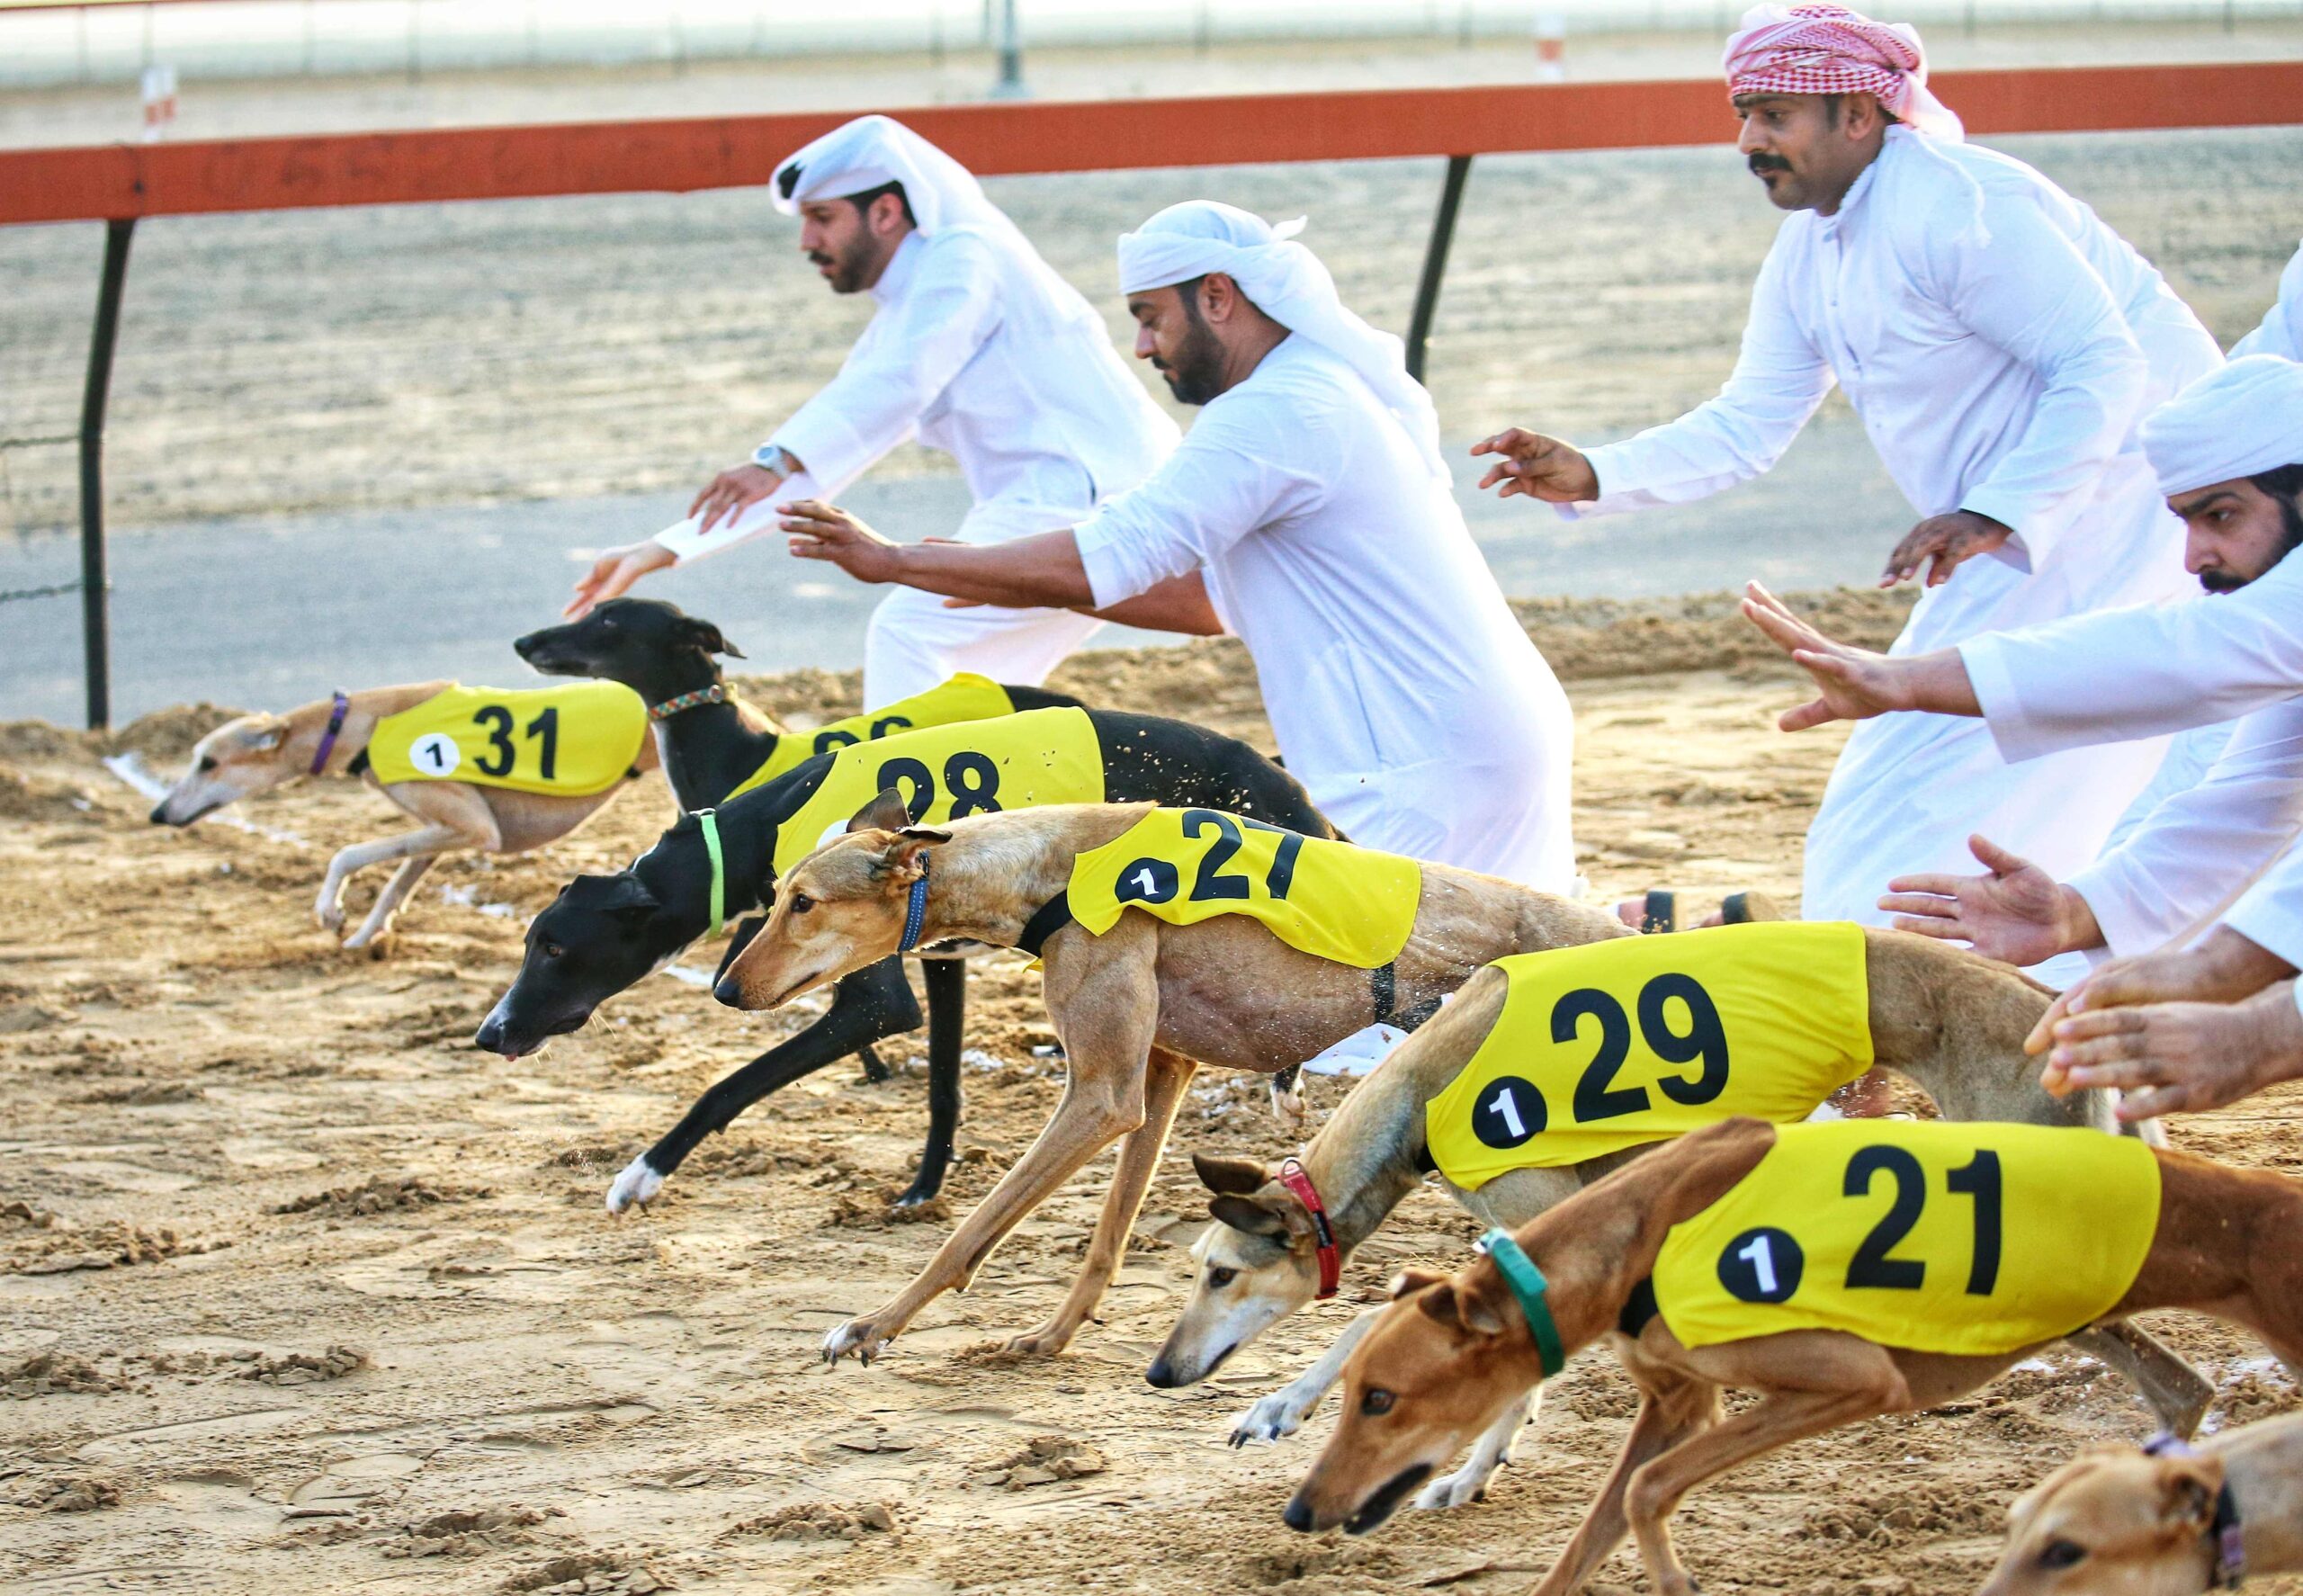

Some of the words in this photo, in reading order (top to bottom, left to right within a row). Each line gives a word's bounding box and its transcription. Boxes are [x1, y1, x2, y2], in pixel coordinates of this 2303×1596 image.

[425, 742, 444, 767] 1
[472, 705, 559, 779] 31
[877, 751, 1004, 822] 28
[1130, 867, 1159, 896] 1
[1182, 808, 1304, 901] 27
[1550, 973, 1729, 1123] 29
[1489, 1088, 1527, 1138] 1
[1842, 1143, 2002, 1296] 21
[1738, 1234, 1778, 1293] 1
